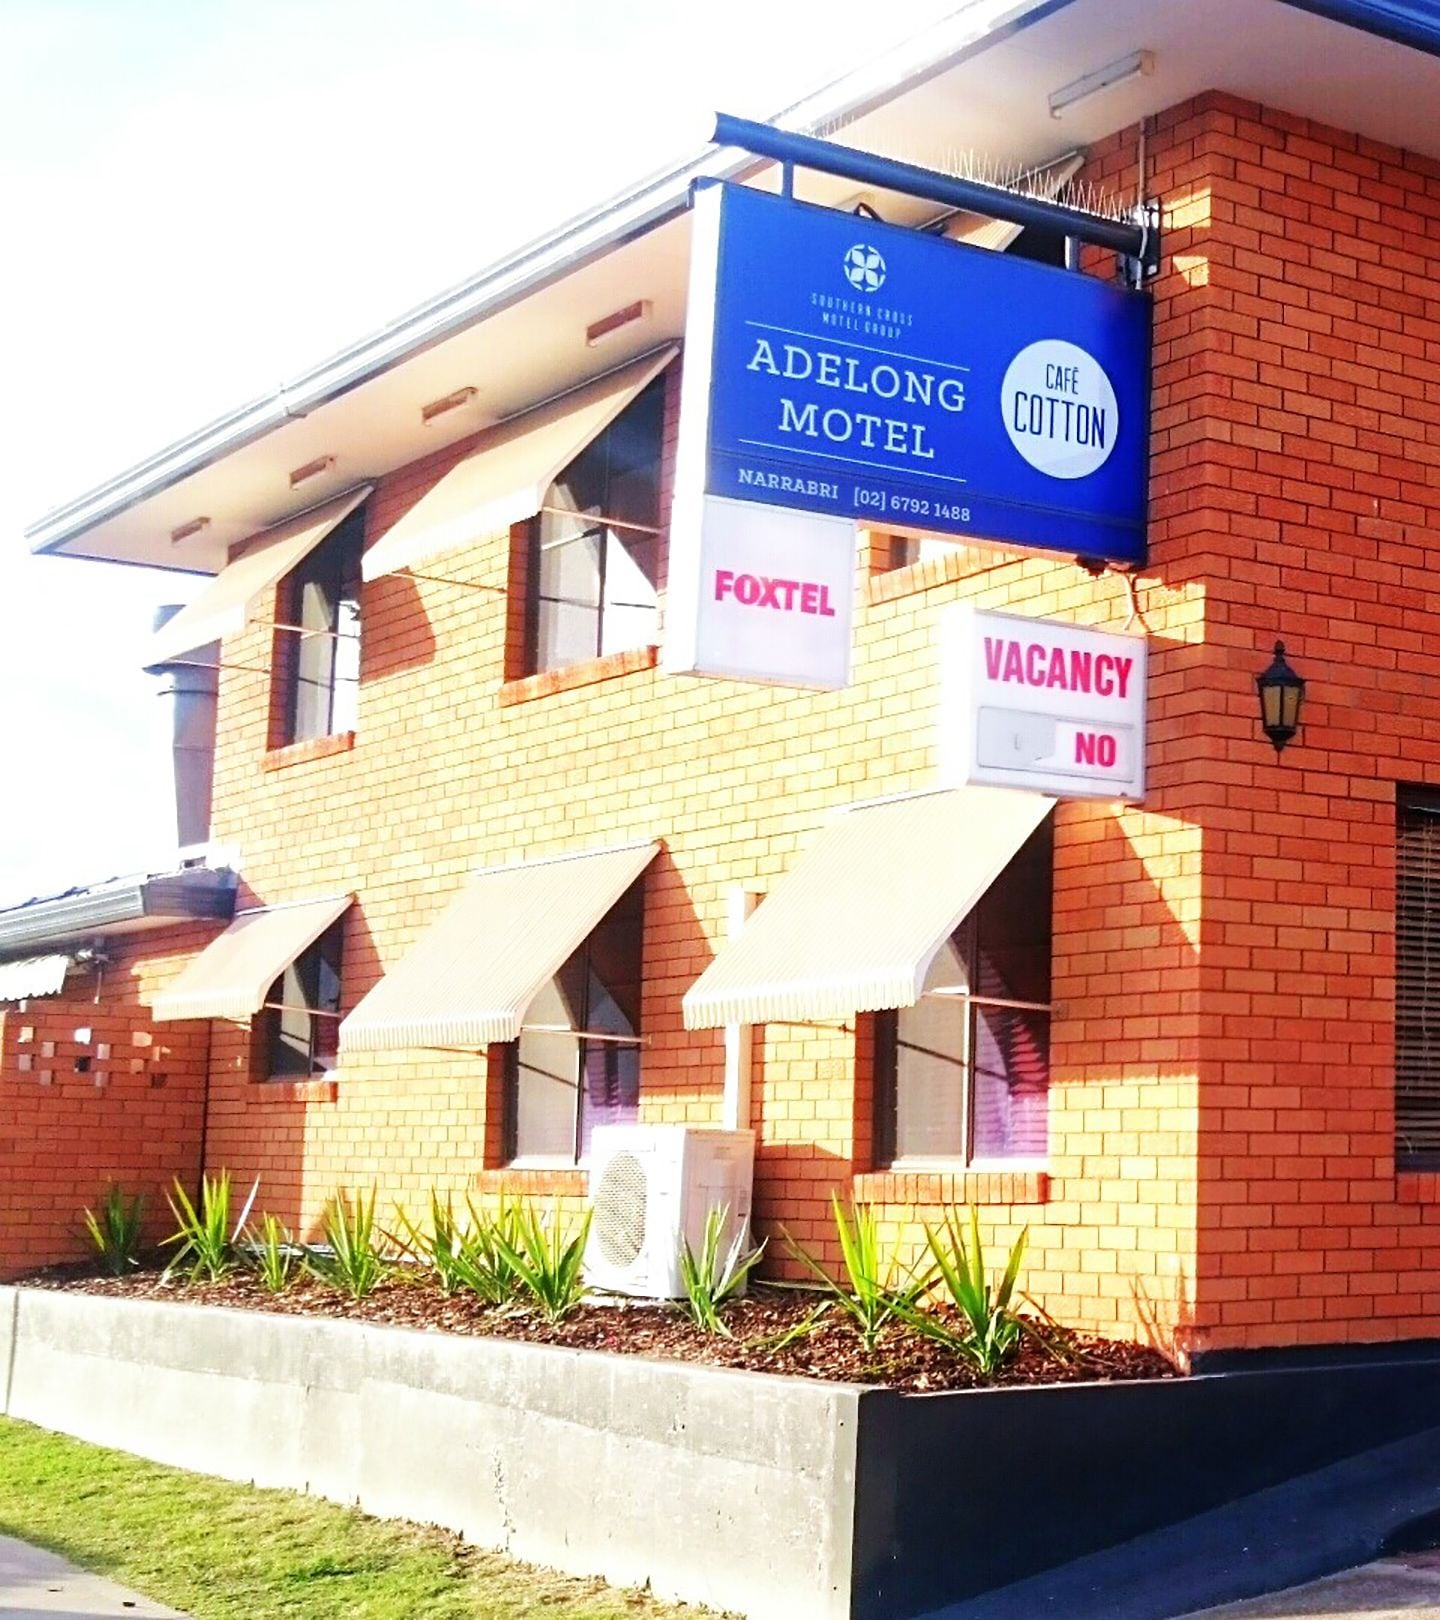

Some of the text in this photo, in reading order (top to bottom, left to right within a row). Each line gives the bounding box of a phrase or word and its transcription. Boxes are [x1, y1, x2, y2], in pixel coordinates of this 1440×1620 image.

[810, 292, 913, 327] SOUTHERN CROSS
[822, 311, 902, 340] MOTEL GROUP
[746, 339, 966, 412] ADELONG
[1045, 362, 1079, 396] CAFÉ
[778, 398, 935, 459] MOTEL
[1013, 391, 1106, 449] COTTON
[737, 467, 839, 500] NARRABRI
[891, 495, 930, 517] 6792
[934, 503, 971, 523] 1488
[714, 569, 836, 617] FOXTEL
[984, 636, 1134, 699] VACANCY
[1074, 731, 1117, 768] NO
